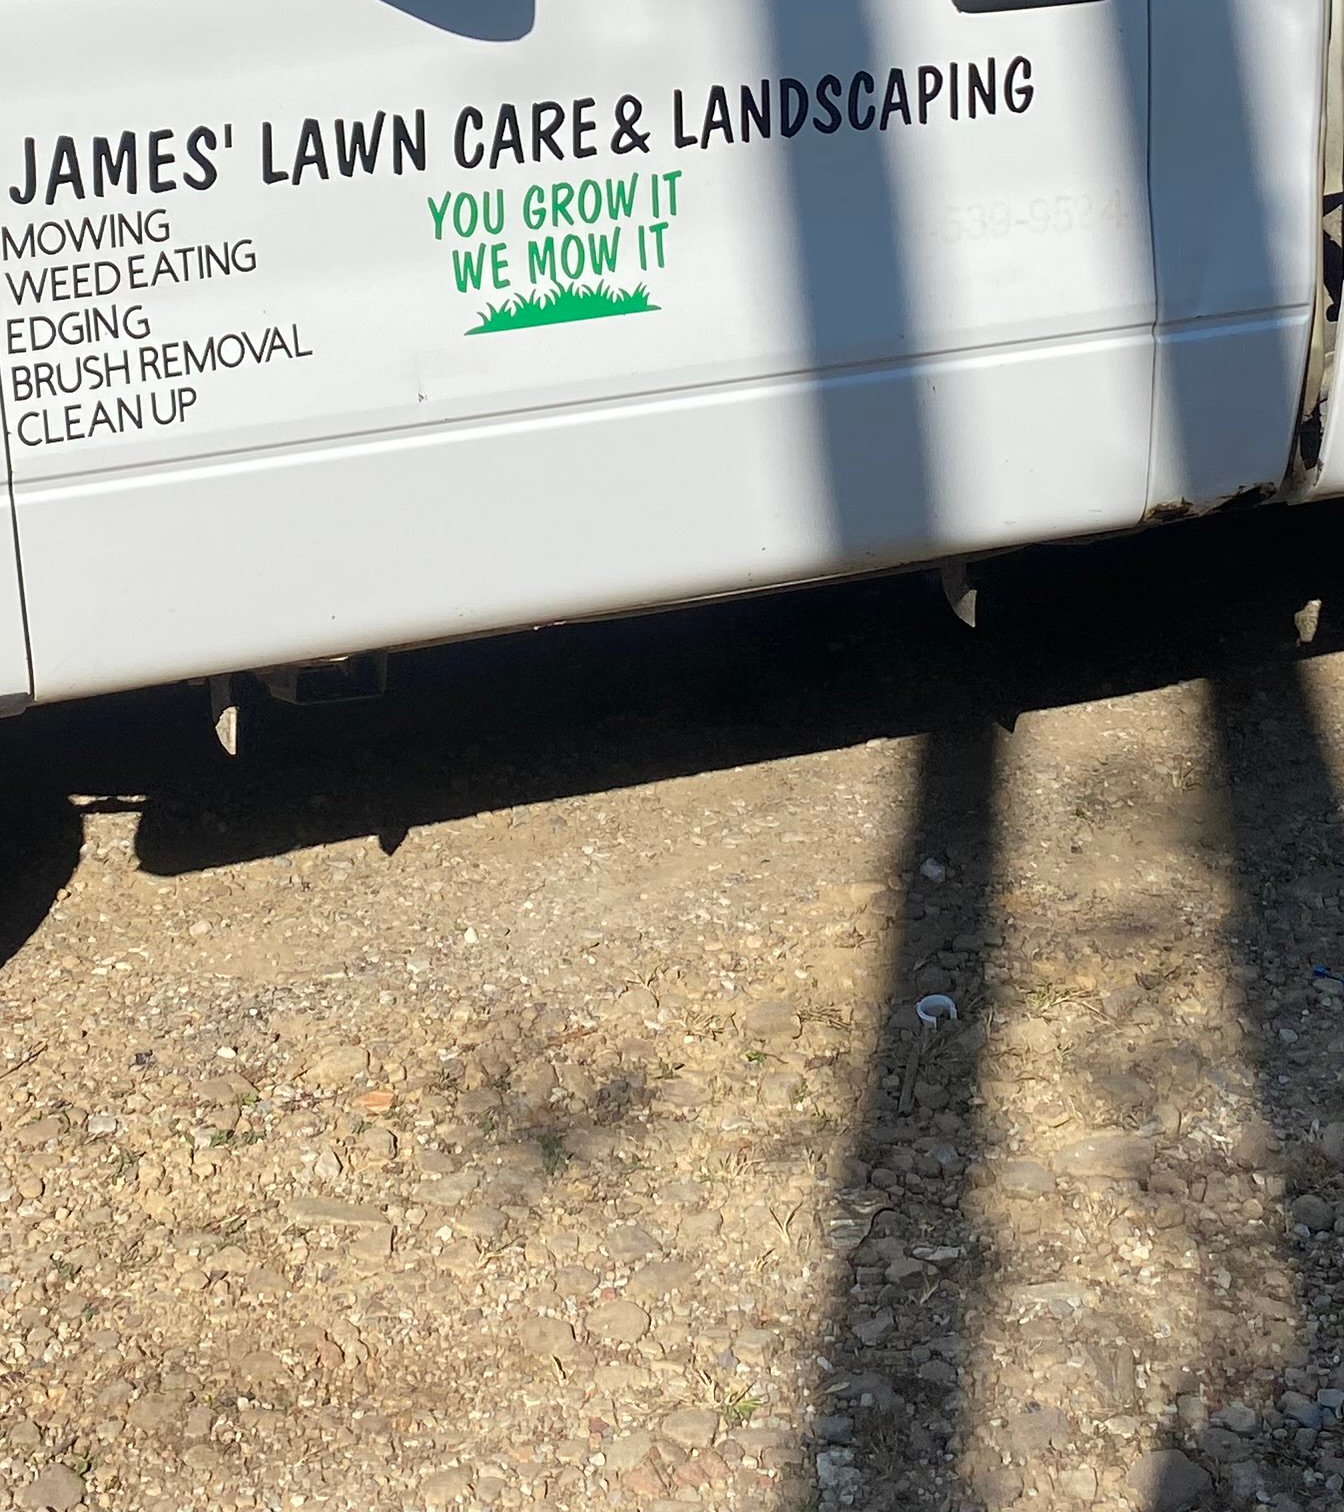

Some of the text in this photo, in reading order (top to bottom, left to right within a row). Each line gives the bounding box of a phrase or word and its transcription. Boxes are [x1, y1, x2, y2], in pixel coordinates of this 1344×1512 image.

[9, 55, 1035, 206] JAMES' LAWN CARE & LANDSCAPING
[1, 209, 171, 261] MOWING
[427, 170, 682, 240] YOU GROW IT
[5, 239, 258, 306] WEED EATING
[452, 222, 670, 293] WE MOW IT
[6, 305, 151, 354] EDGING
[11, 323, 313, 402] BRUSH REMOVAL
[17, 386, 197, 447] CLEAN UP
